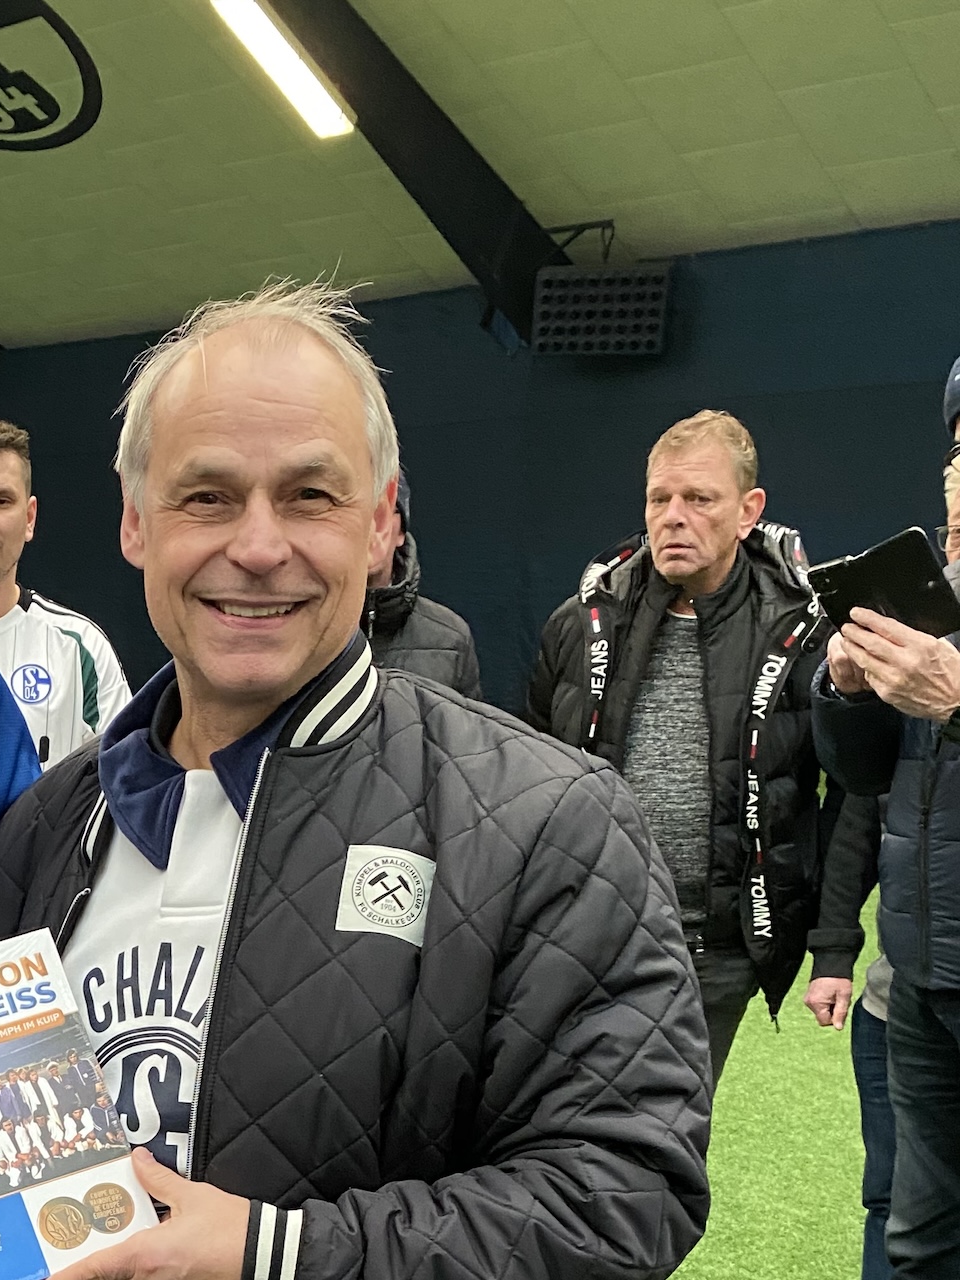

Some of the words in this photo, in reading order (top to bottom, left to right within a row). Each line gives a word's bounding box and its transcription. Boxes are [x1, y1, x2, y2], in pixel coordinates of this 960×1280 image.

[24, 687, 38, 700] 04
[591, 639, 608, 700] JEANS
[751, 653, 788, 720] TOMMY
[746, 769, 760, 830] JEANS
[355, 866, 375, 897] KUMPEL
[381, 859, 421, 886] MALOCHER
[415, 887, 423, 910] CLUB
[750, 874, 773, 938] TOMMY
[358, 902, 368, 913] FC
[367, 911, 406, 926] SCHALKE
[406, 912, 415, 922] 04
[23, 1020, 35, 1031] IM
[37, 1013, 60, 1028] KUIP
